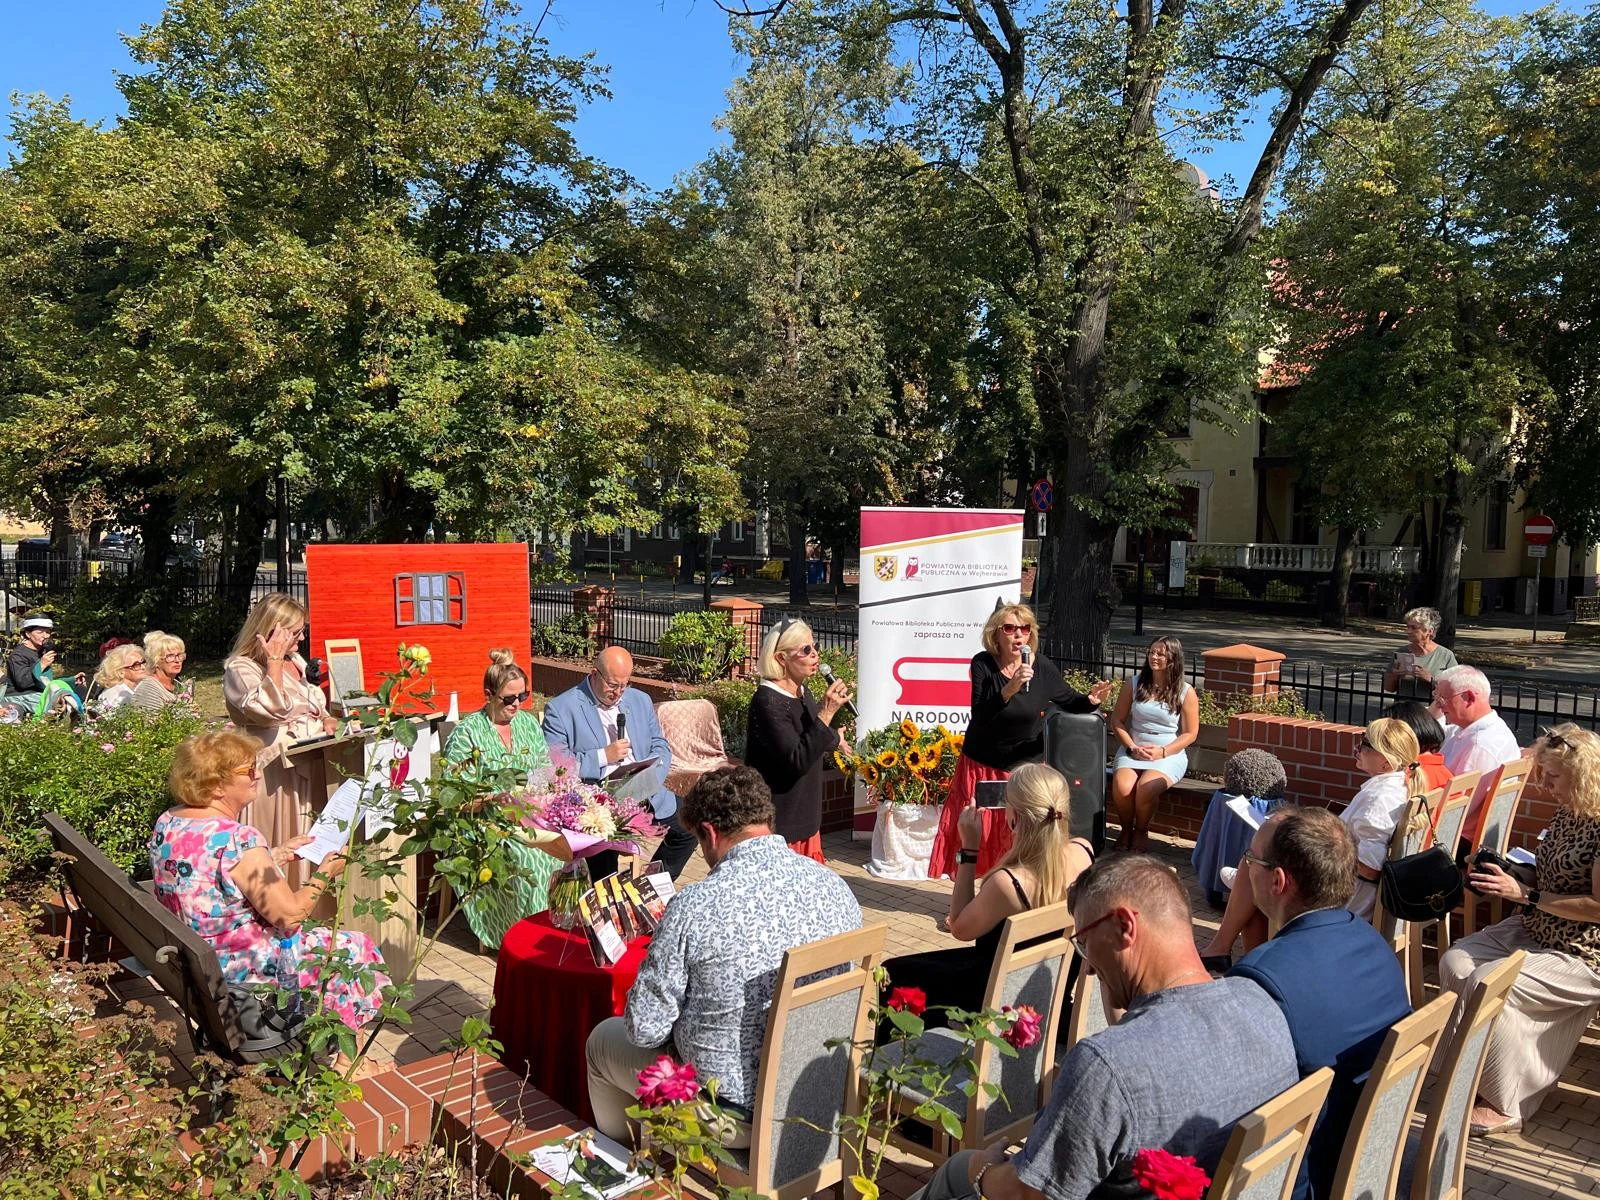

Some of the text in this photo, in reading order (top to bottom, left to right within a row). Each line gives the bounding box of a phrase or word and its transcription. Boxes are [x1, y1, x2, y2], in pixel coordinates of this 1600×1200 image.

[920, 562, 966, 570] POWIATOWA
[913, 631, 965, 639] zaprasza na
[891, 710, 972, 724] NARODOW
